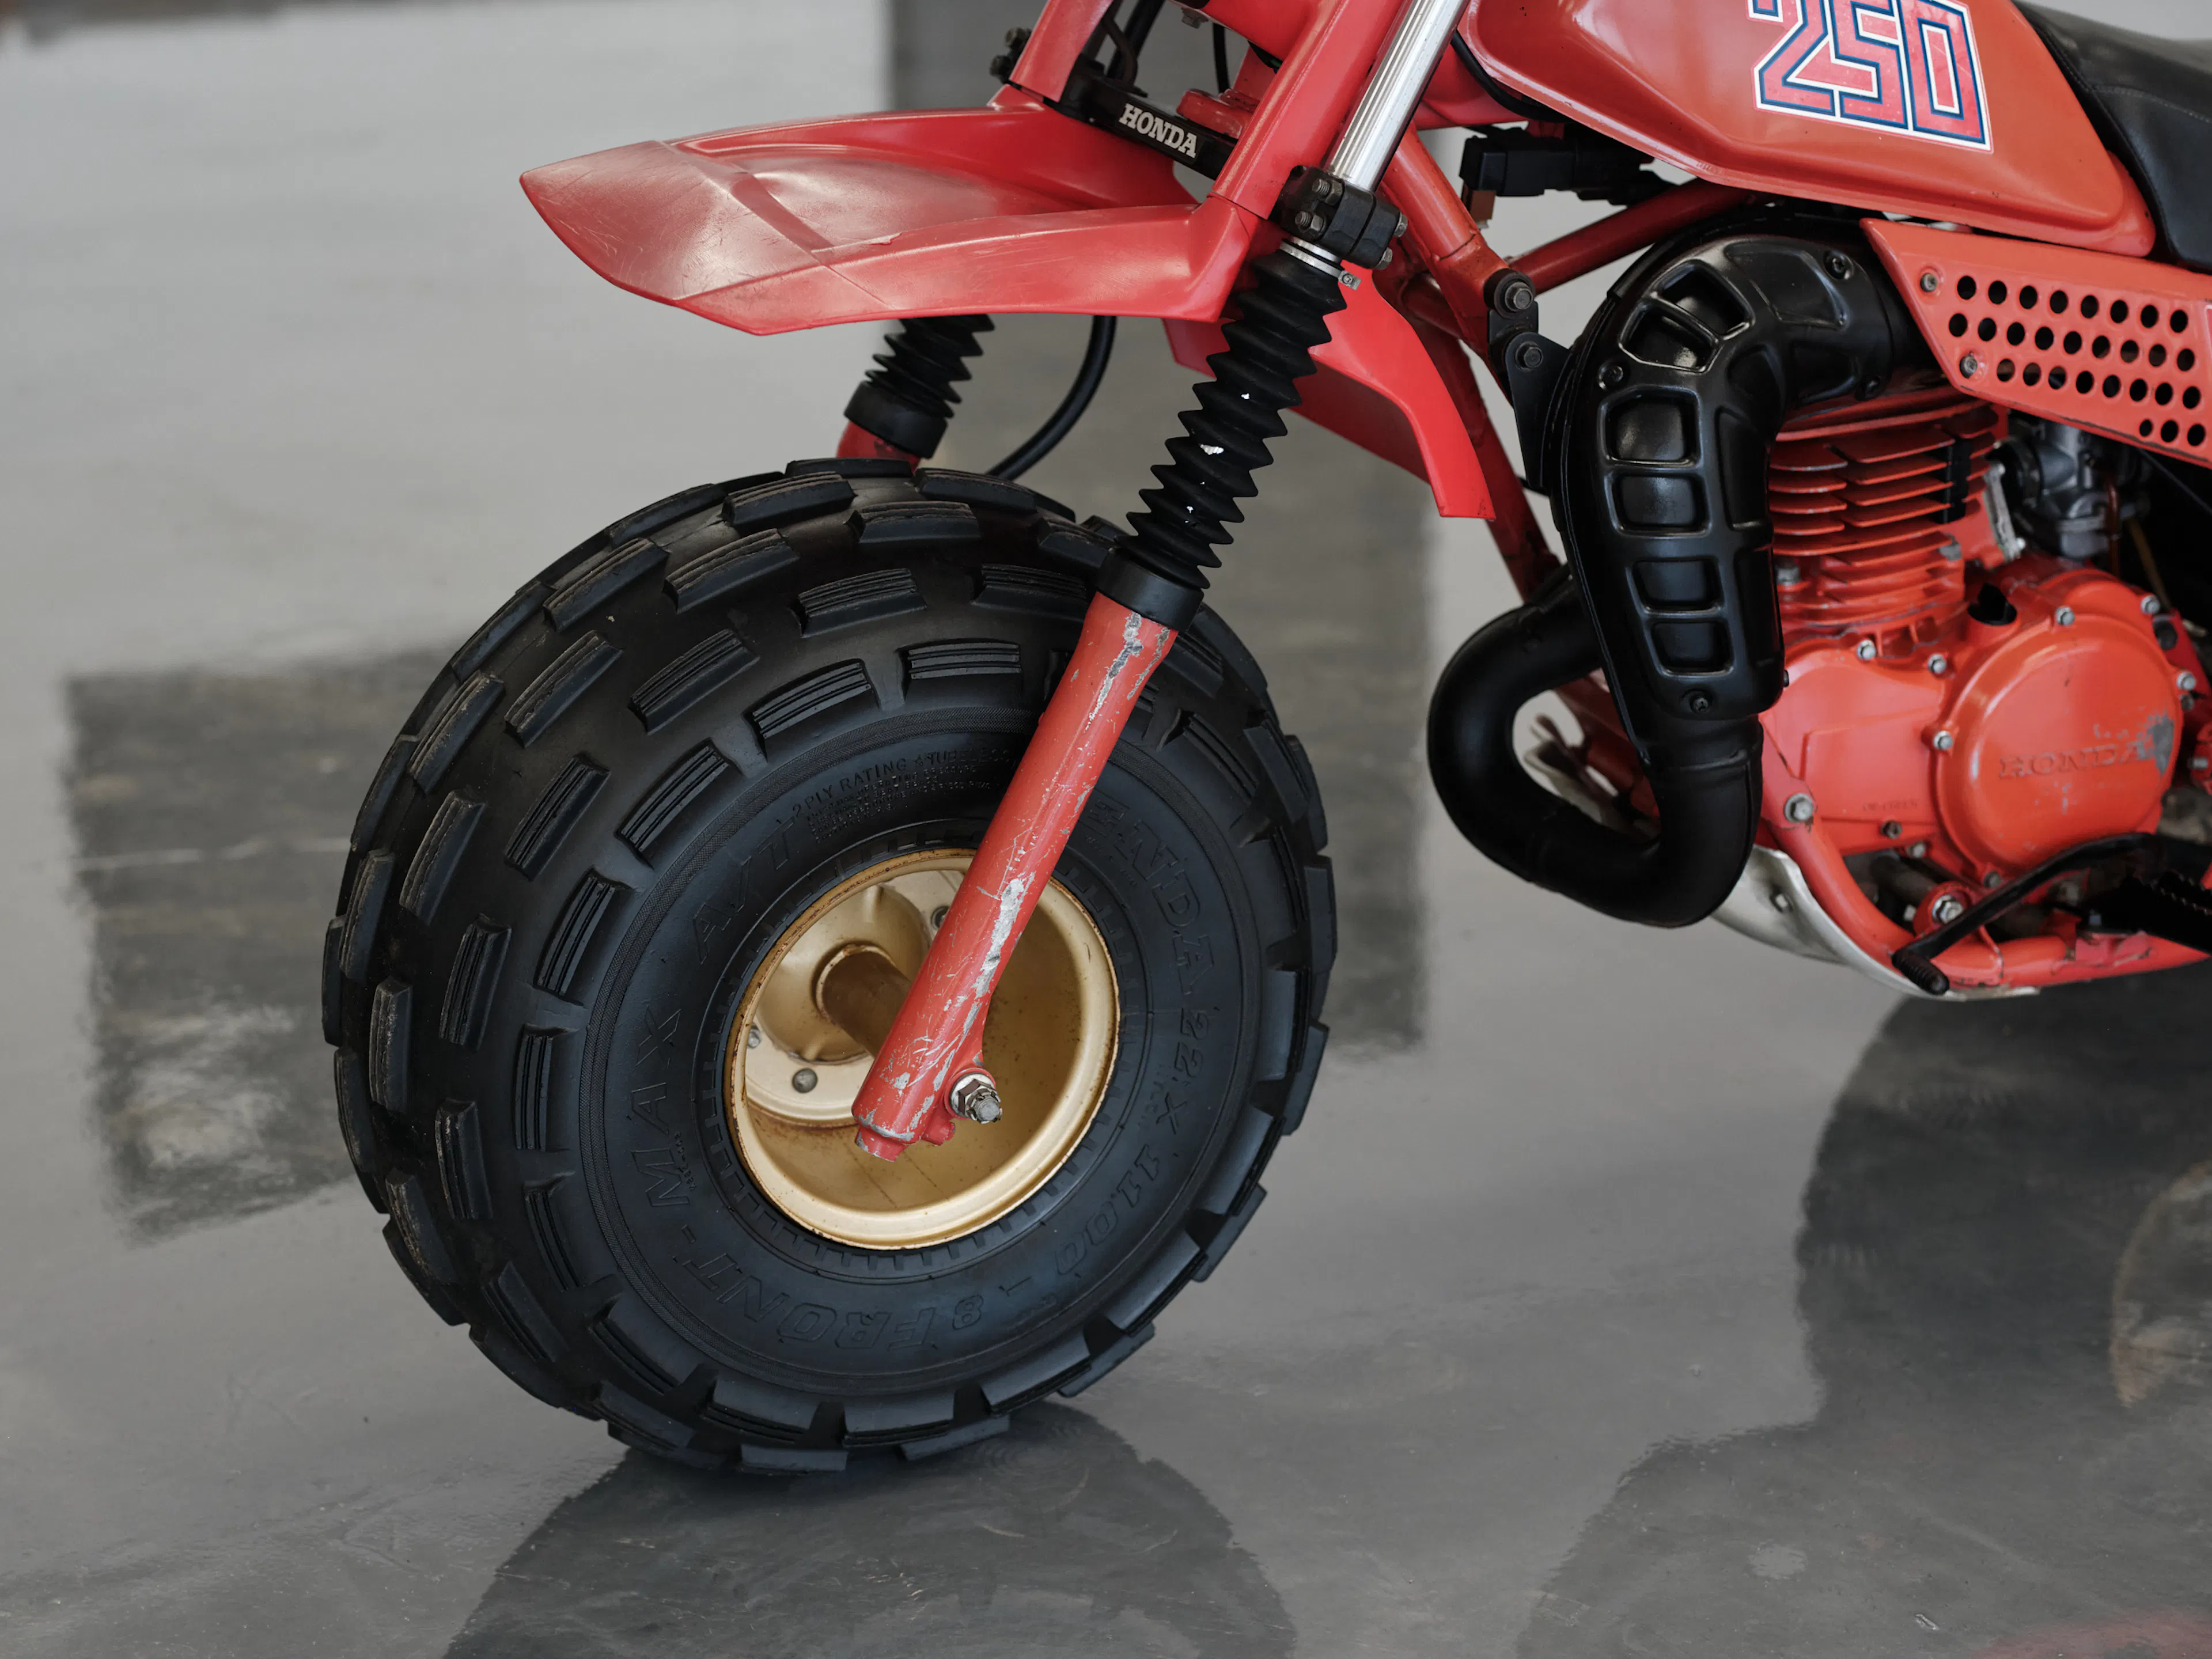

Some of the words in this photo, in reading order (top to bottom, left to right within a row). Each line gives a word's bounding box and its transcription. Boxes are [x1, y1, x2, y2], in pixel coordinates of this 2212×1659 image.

[1745, 0, 1994, 152] 250
[1119, 103, 1197, 158] HONDA
[838, 757, 907, 791] RATING
[1998, 740, 2155, 779] HONDA
